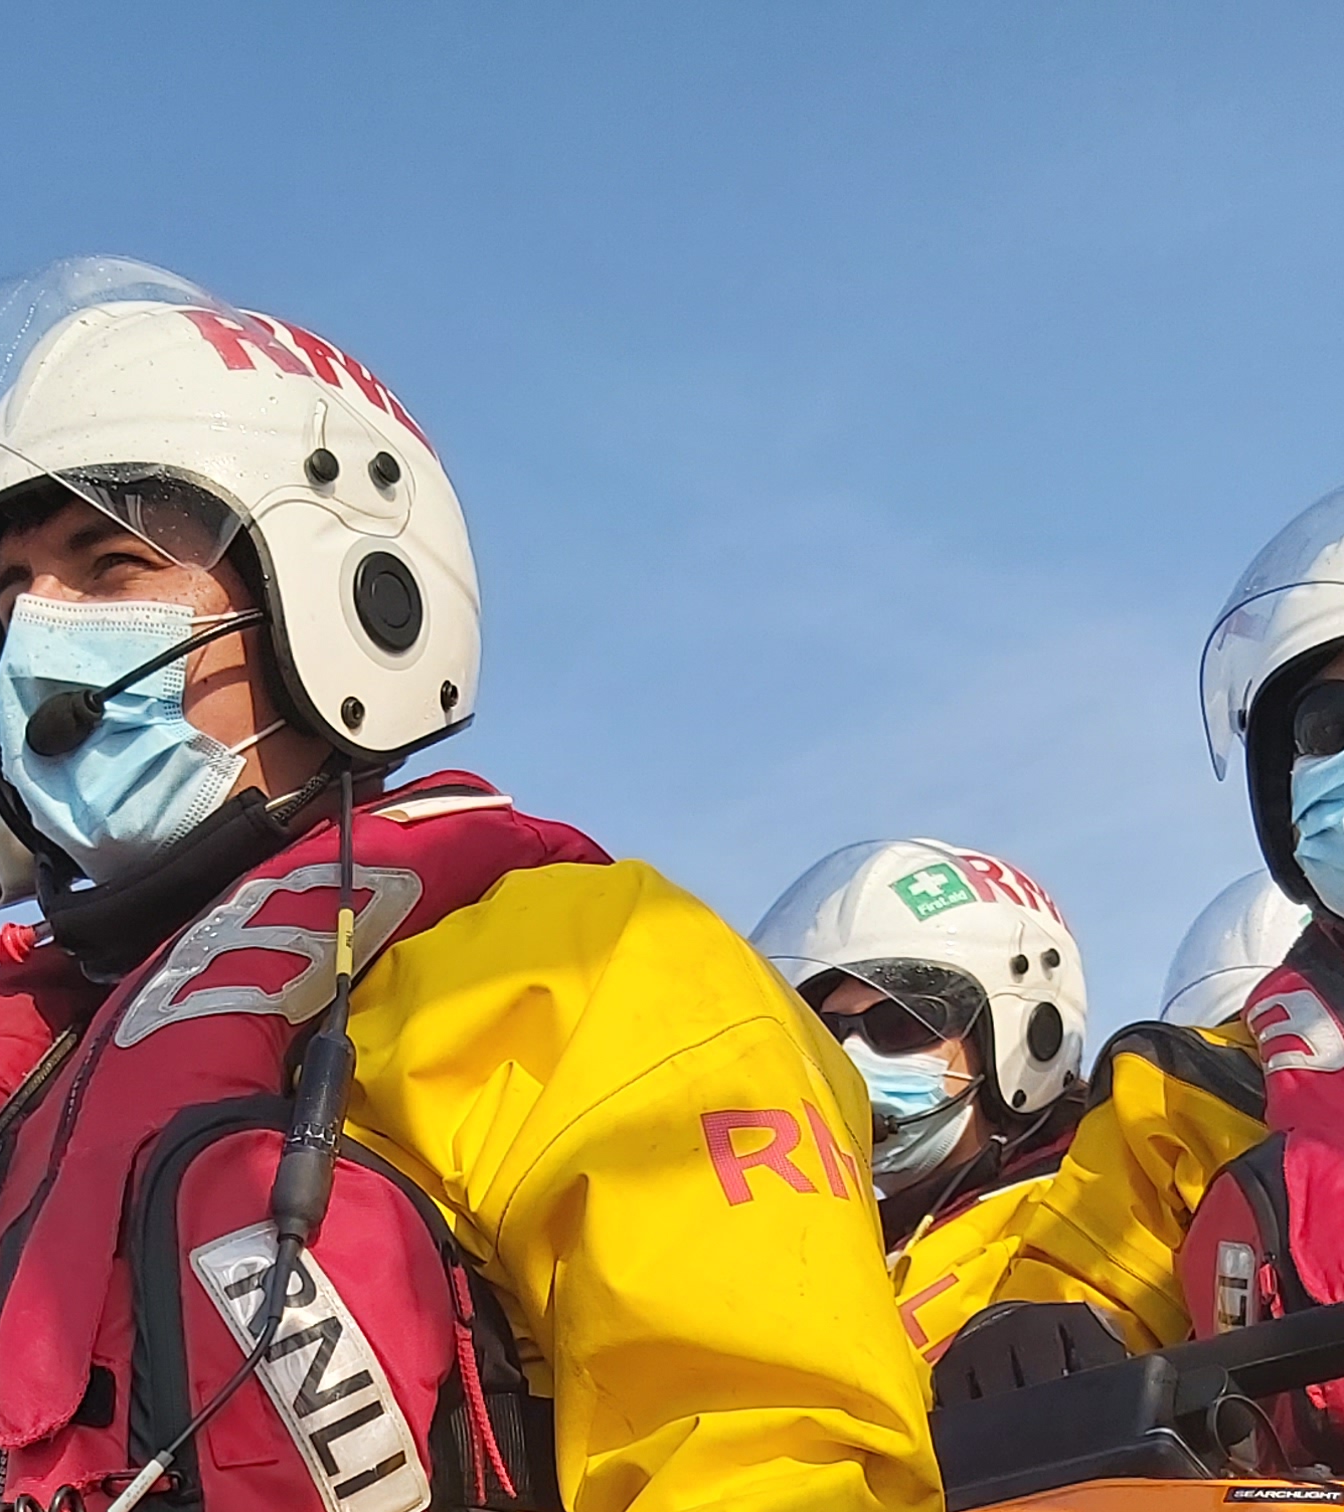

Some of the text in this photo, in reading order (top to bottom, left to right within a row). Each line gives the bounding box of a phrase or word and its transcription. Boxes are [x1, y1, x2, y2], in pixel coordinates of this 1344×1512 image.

[917, 896, 950, 916] First
[223, 1255, 407, 1500] RNLI
[1233, 1489, 1342, 1501] SEARCHLIGHT
